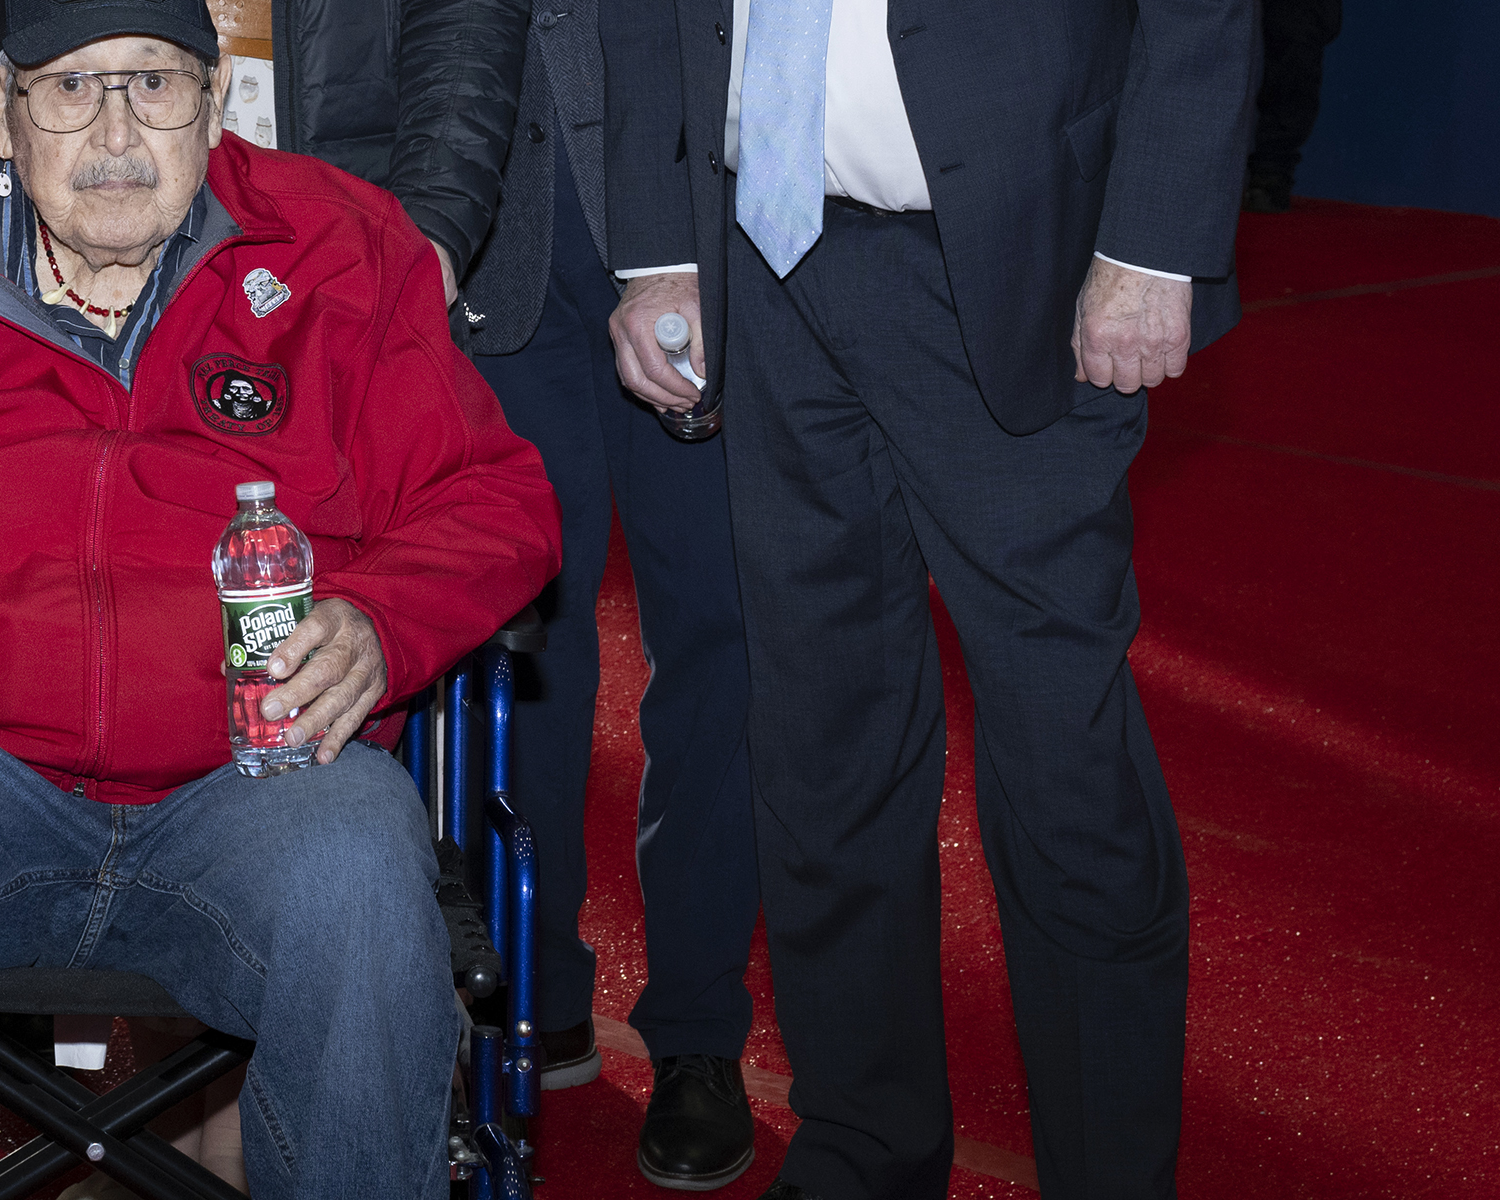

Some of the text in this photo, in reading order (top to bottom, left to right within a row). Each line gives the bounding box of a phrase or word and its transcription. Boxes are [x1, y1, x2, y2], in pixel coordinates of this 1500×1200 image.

[197, 362, 214, 380] NEZ
[214, 359, 251, 372] PERCE
[200, 398, 246, 431] TREATY
[256, 418, 273, 431] OF
[238, 602, 296, 637] Poland
